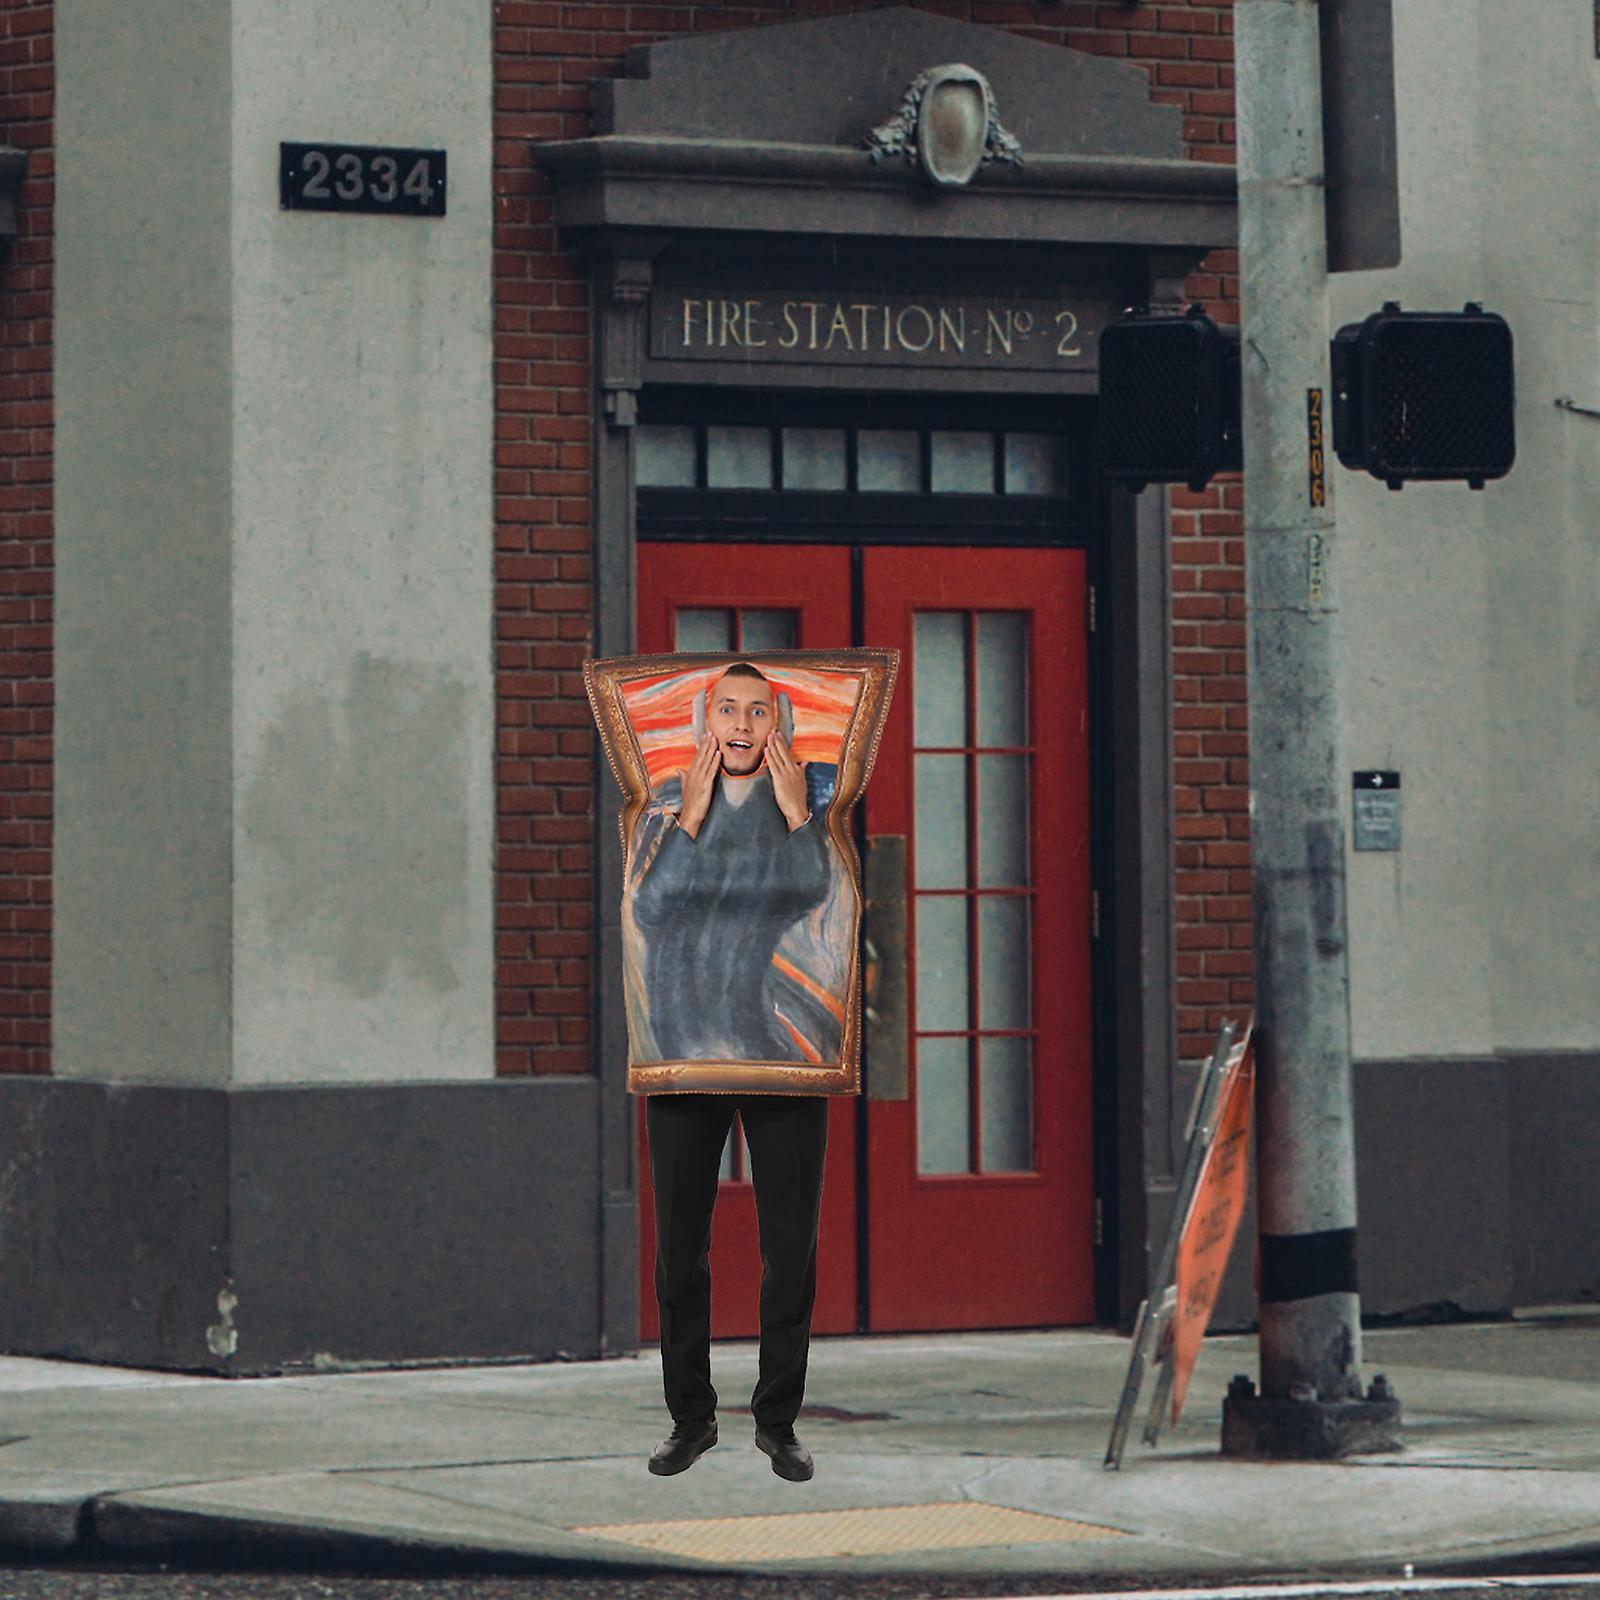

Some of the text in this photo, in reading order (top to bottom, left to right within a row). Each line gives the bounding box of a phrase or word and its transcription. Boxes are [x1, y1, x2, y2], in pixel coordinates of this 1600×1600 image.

[302, 151, 434, 205] 2334
[683, 299, 766, 346] FIRE
[778, 302, 965, 351] STATION
[1055, 311, 1080, 356] 2
[1310, 390, 1322, 506] 2306
